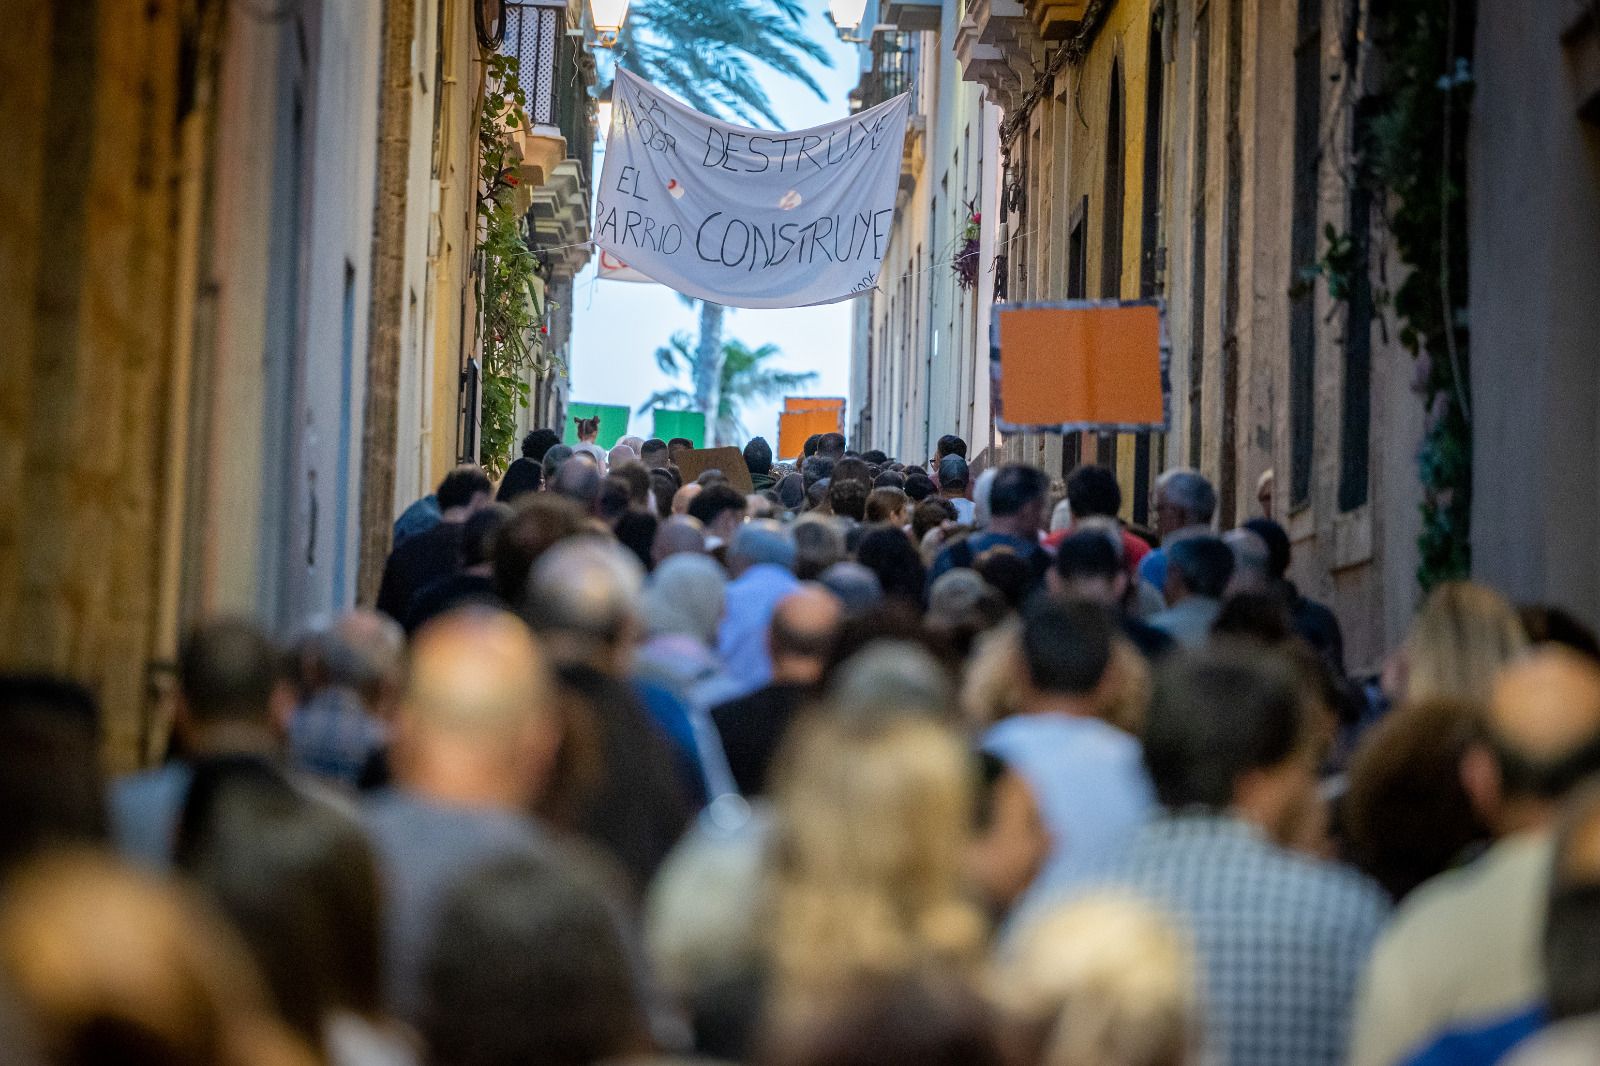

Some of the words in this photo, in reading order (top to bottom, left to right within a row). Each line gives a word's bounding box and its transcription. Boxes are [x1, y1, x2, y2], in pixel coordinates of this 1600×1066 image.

[636, 88, 668, 127] LA
[702, 113, 889, 173] DESTRUYE
[616, 165, 649, 202] EL
[695, 208, 893, 272] CONSTRUYE
